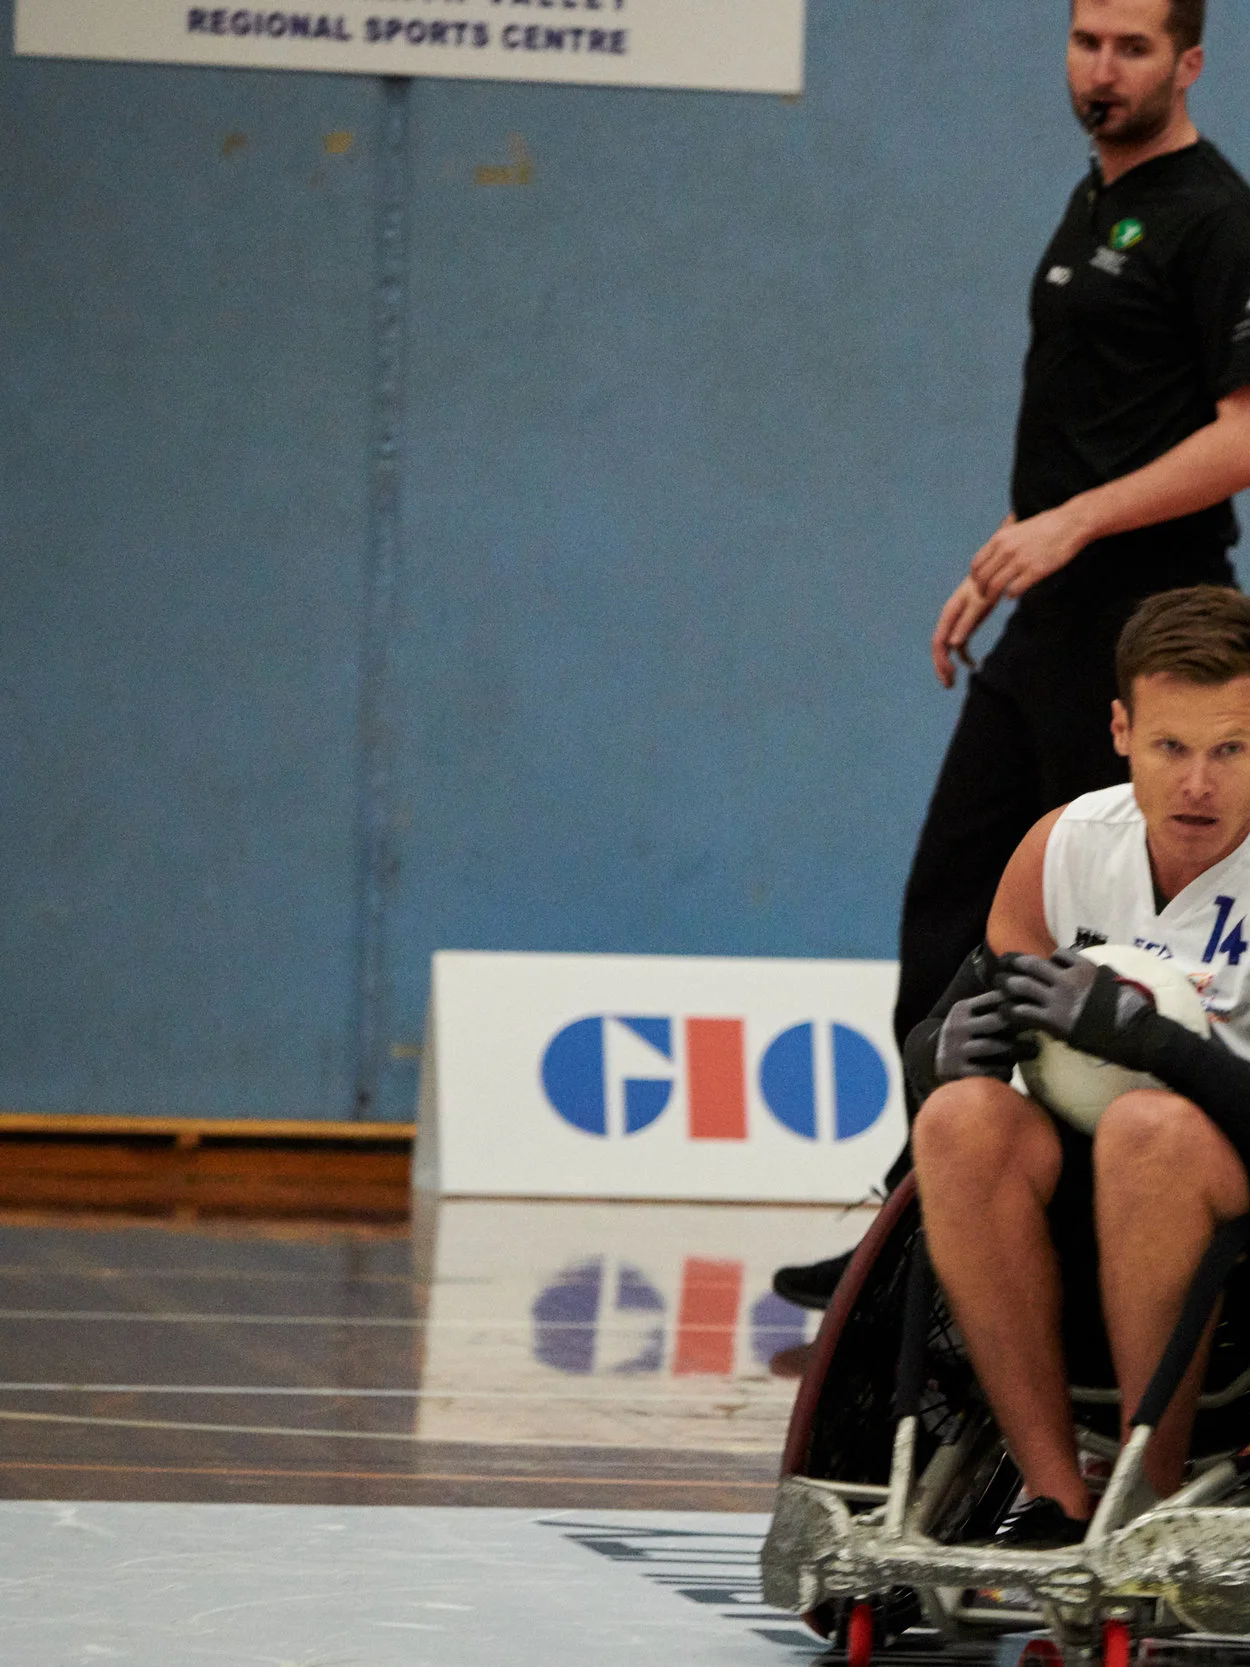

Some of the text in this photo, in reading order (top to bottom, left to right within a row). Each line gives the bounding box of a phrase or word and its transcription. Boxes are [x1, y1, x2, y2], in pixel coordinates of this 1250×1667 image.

[187, 7, 625, 54] REGIONAL SPORTS CENTRE
[1201, 895, 1248, 966] 14
[540, 1013, 889, 1143] GIO
